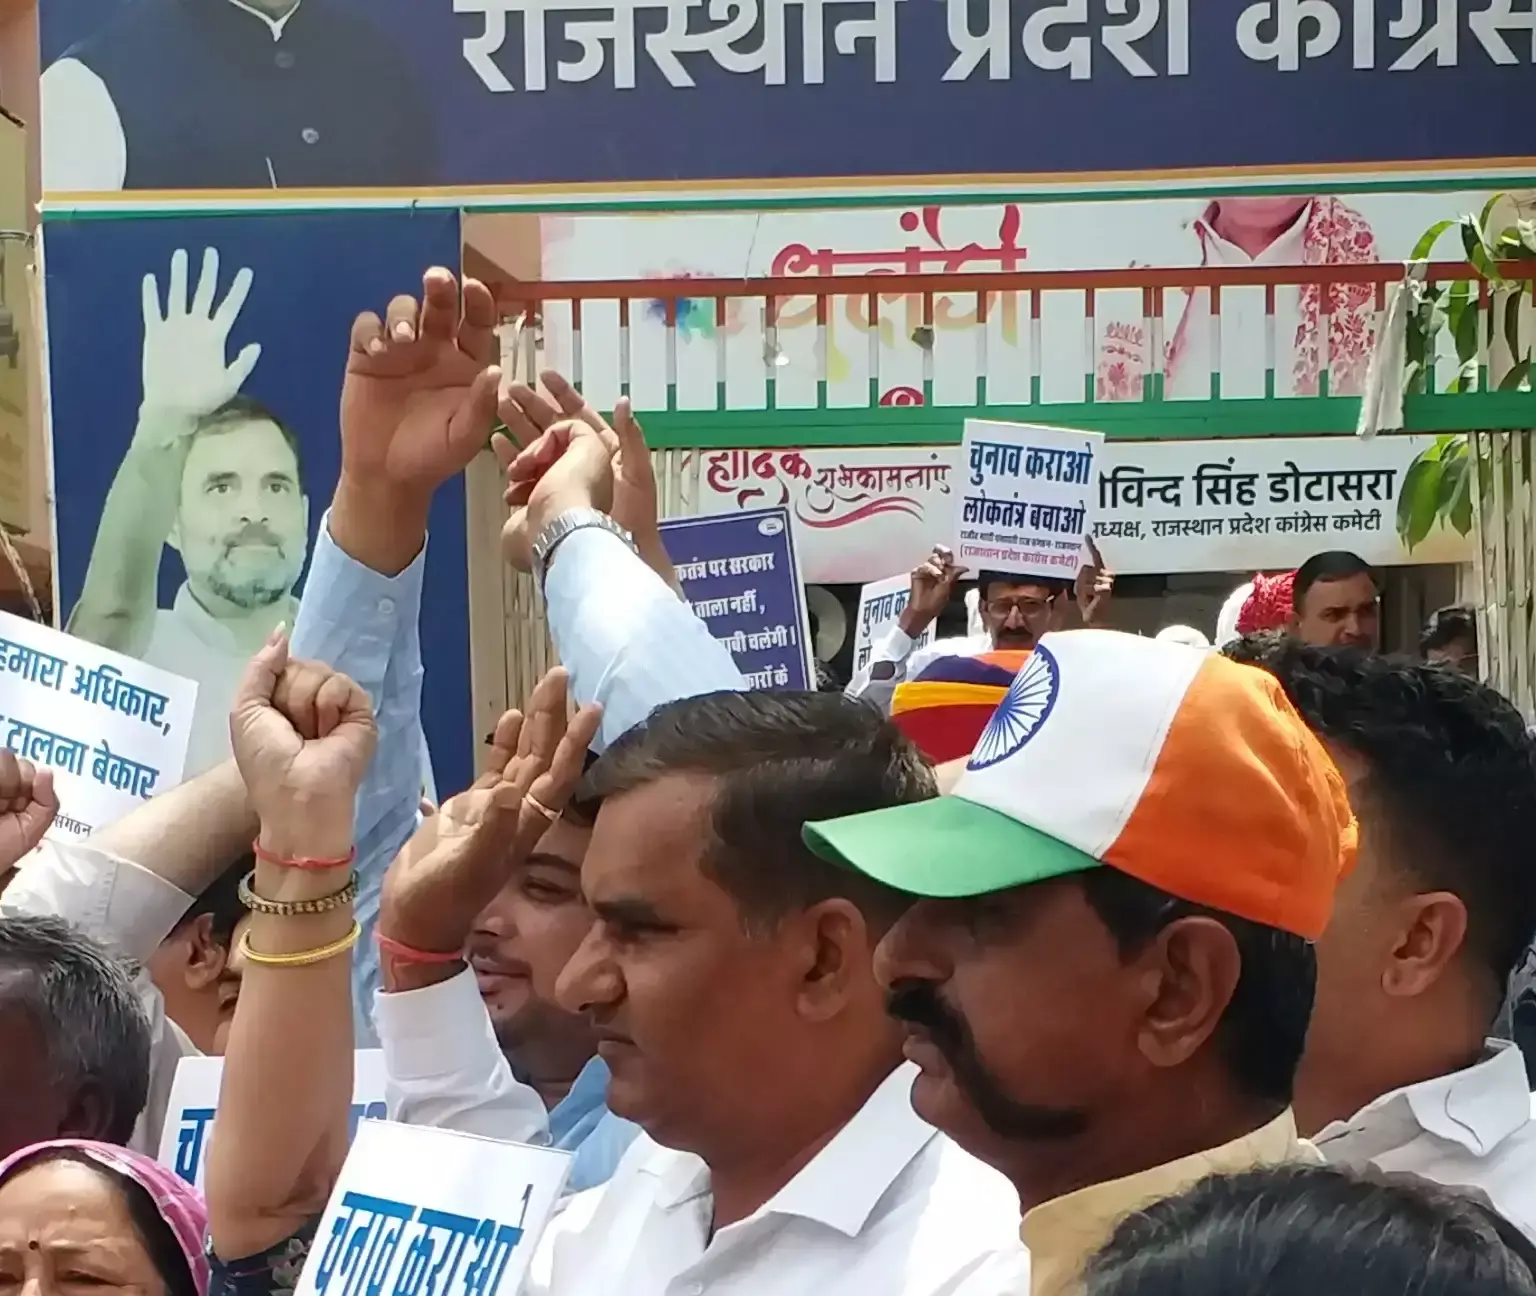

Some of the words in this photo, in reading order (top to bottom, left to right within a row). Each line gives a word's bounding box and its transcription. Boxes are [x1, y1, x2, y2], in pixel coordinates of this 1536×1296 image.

[453, 0, 907, 92] राजस्थान
[969, 440, 1024, 486] चुनाव
[1025, 441, 1094, 485] कराओ
[1099, 465, 1184, 510] ोविन्द
[1193, 456, 1260, 508] सिंह
[1268, 460, 1397, 503] डोटासरा
[962, 489, 1028, 529] लोकतंत्र
[1029, 500, 1086, 535] बचाओ
[1092, 518, 1146, 541] ध्यक्ष,
[1151, 516, 1224, 538] राजस्थान
[1228, 511, 1271, 537] प्रदेश
[1275, 508, 1329, 536] कांग्रेस
[1332, 508, 1381, 533] कमेटी
[709, 559, 727, 577] पर
[728, 552, 775, 576] सरकार
[863, 593, 894, 638] चुनाव
[70, 664, 171, 736] अधिकार,
[6, 717, 89, 776] टालना
[91, 739, 160, 800] बेकार
